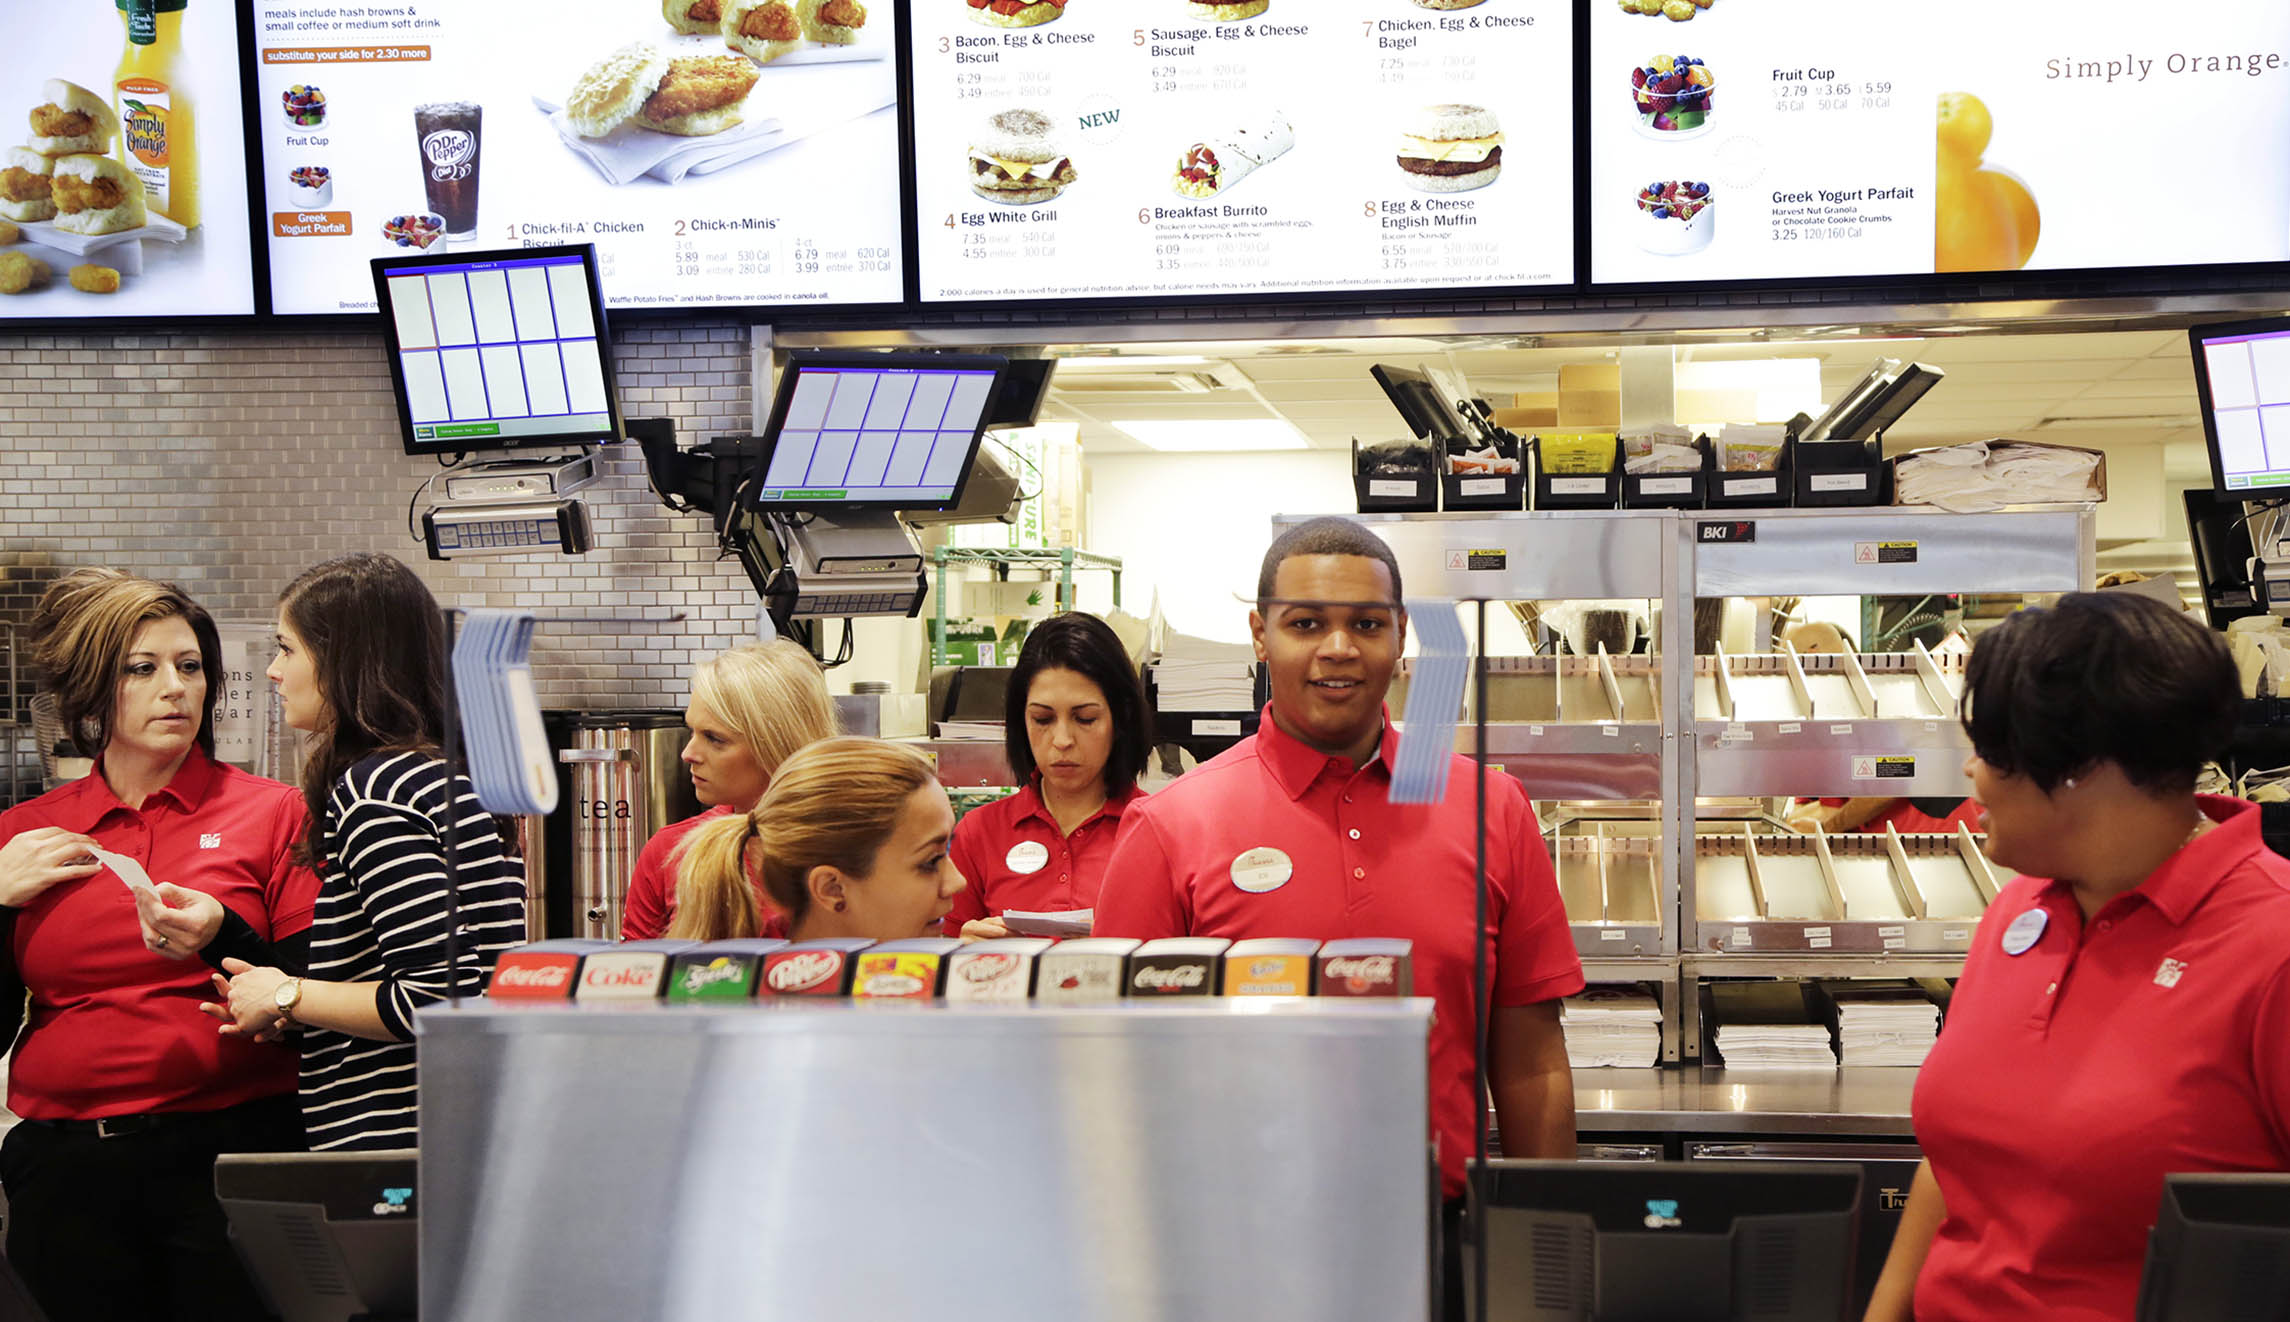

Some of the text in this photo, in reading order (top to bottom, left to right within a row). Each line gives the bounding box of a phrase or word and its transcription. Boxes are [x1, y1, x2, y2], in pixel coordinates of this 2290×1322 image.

[265, 7, 416, 19] meals include hash browns &
[265, 18, 440, 31] small coffee or medium soft drink
[1362, 21, 1374, 38] 7
[1440, 18, 1464, 32] Egg
[1469, 16, 1480, 28] &
[1484, 15, 1535, 27] Cheese
[1133, 29, 1145, 46] 5
[1215, 26, 1240, 40] Egg
[1244, 25, 1255, 37] &
[1260, 24, 1308, 36] Cheese
[938, 37, 950, 53] 3
[1004, 33, 1028, 48] Egg
[1032, 33, 1043, 45] &
[1047, 32, 1095, 44] Cheese
[1378, 36, 1417, 50] Bagel
[267, 49, 427, 62] substitute your side for 2.30 more
[1151, 44, 1195, 56] Biscuit
[956, 52, 999, 63] Biscuit
[1152, 66, 1176, 77] 6.29
[1772, 68, 1835, 81] Fruit Cup
[2046, 54, 2153, 82] Simply
[957, 73, 982, 84] 6.29
[958, 88, 982, 99] 3.49
[1152, 81, 1176, 93] 3.49
[1782, 82, 1892, 97] 2.79 3.65 5.59
[1776, 100, 1788, 112] 45
[1790, 100, 1804, 111] Cal
[1818, 99, 1831, 110] 50
[1834, 99, 1847, 110] Cal
[1876, 97, 1890, 108] Cal
[124, 108, 164, 138] Simply
[1078, 109, 1120, 130] NEW
[126, 132, 166, 158] Orange
[287, 136, 329, 146] Fruit Cup
[442, 136, 457, 148] Dr
[430, 139, 467, 160] Pepper
[1772, 187, 1914, 204] Greek Yogurt Parfait
[1364, 198, 1475, 217] 8 Egg & Cheese
[1772, 208, 1804, 216] Harvest
[1824, 206, 1857, 214] Granola
[298, 214, 327, 222] Greek
[944, 210, 1057, 230] 4 Egg White Grill
[1138, 205, 1268, 224] 6 Breakfast Burrito
[1784, 217, 1825, 225] Chocolate
[1828, 216, 1857, 224] Cookie
[1859, 215, 1892, 223] Crumbs
[674, 220, 686, 236] 2
[1251, 220, 1291, 228] scrambled
[1382, 214, 1477, 230] English Muffin
[280, 223, 346, 235] Yogurt Parfait
[507, 224, 518, 240] 1
[594, 221, 644, 233] Chicken
[1772, 227, 1862, 240] 3.25 120/160 Cal
[523, 239, 565, 248] Biscuit
[963, 233, 986, 244] 7.35
[675, 250, 770, 262] 5.89 meal 530 Cal
[795, 247, 890, 260] 6.79 meal 620 Cal
[963, 248, 986, 259] 4.55
[1156, 244, 1180, 255] 6.09
[1382, 245, 1406, 255] 6.55
[601, 253, 615, 264] Cal
[1156, 259, 1180, 270] 3.35
[602, 267, 615, 277] Cal
[676, 263, 771, 276] 3.09 280 Cal
[795, 260, 890, 273] 3.99 370 Cal
[1704, 526, 1727, 539] BKI
[580, 796, 631, 818] tea
[586, 967, 653, 987] Coke
